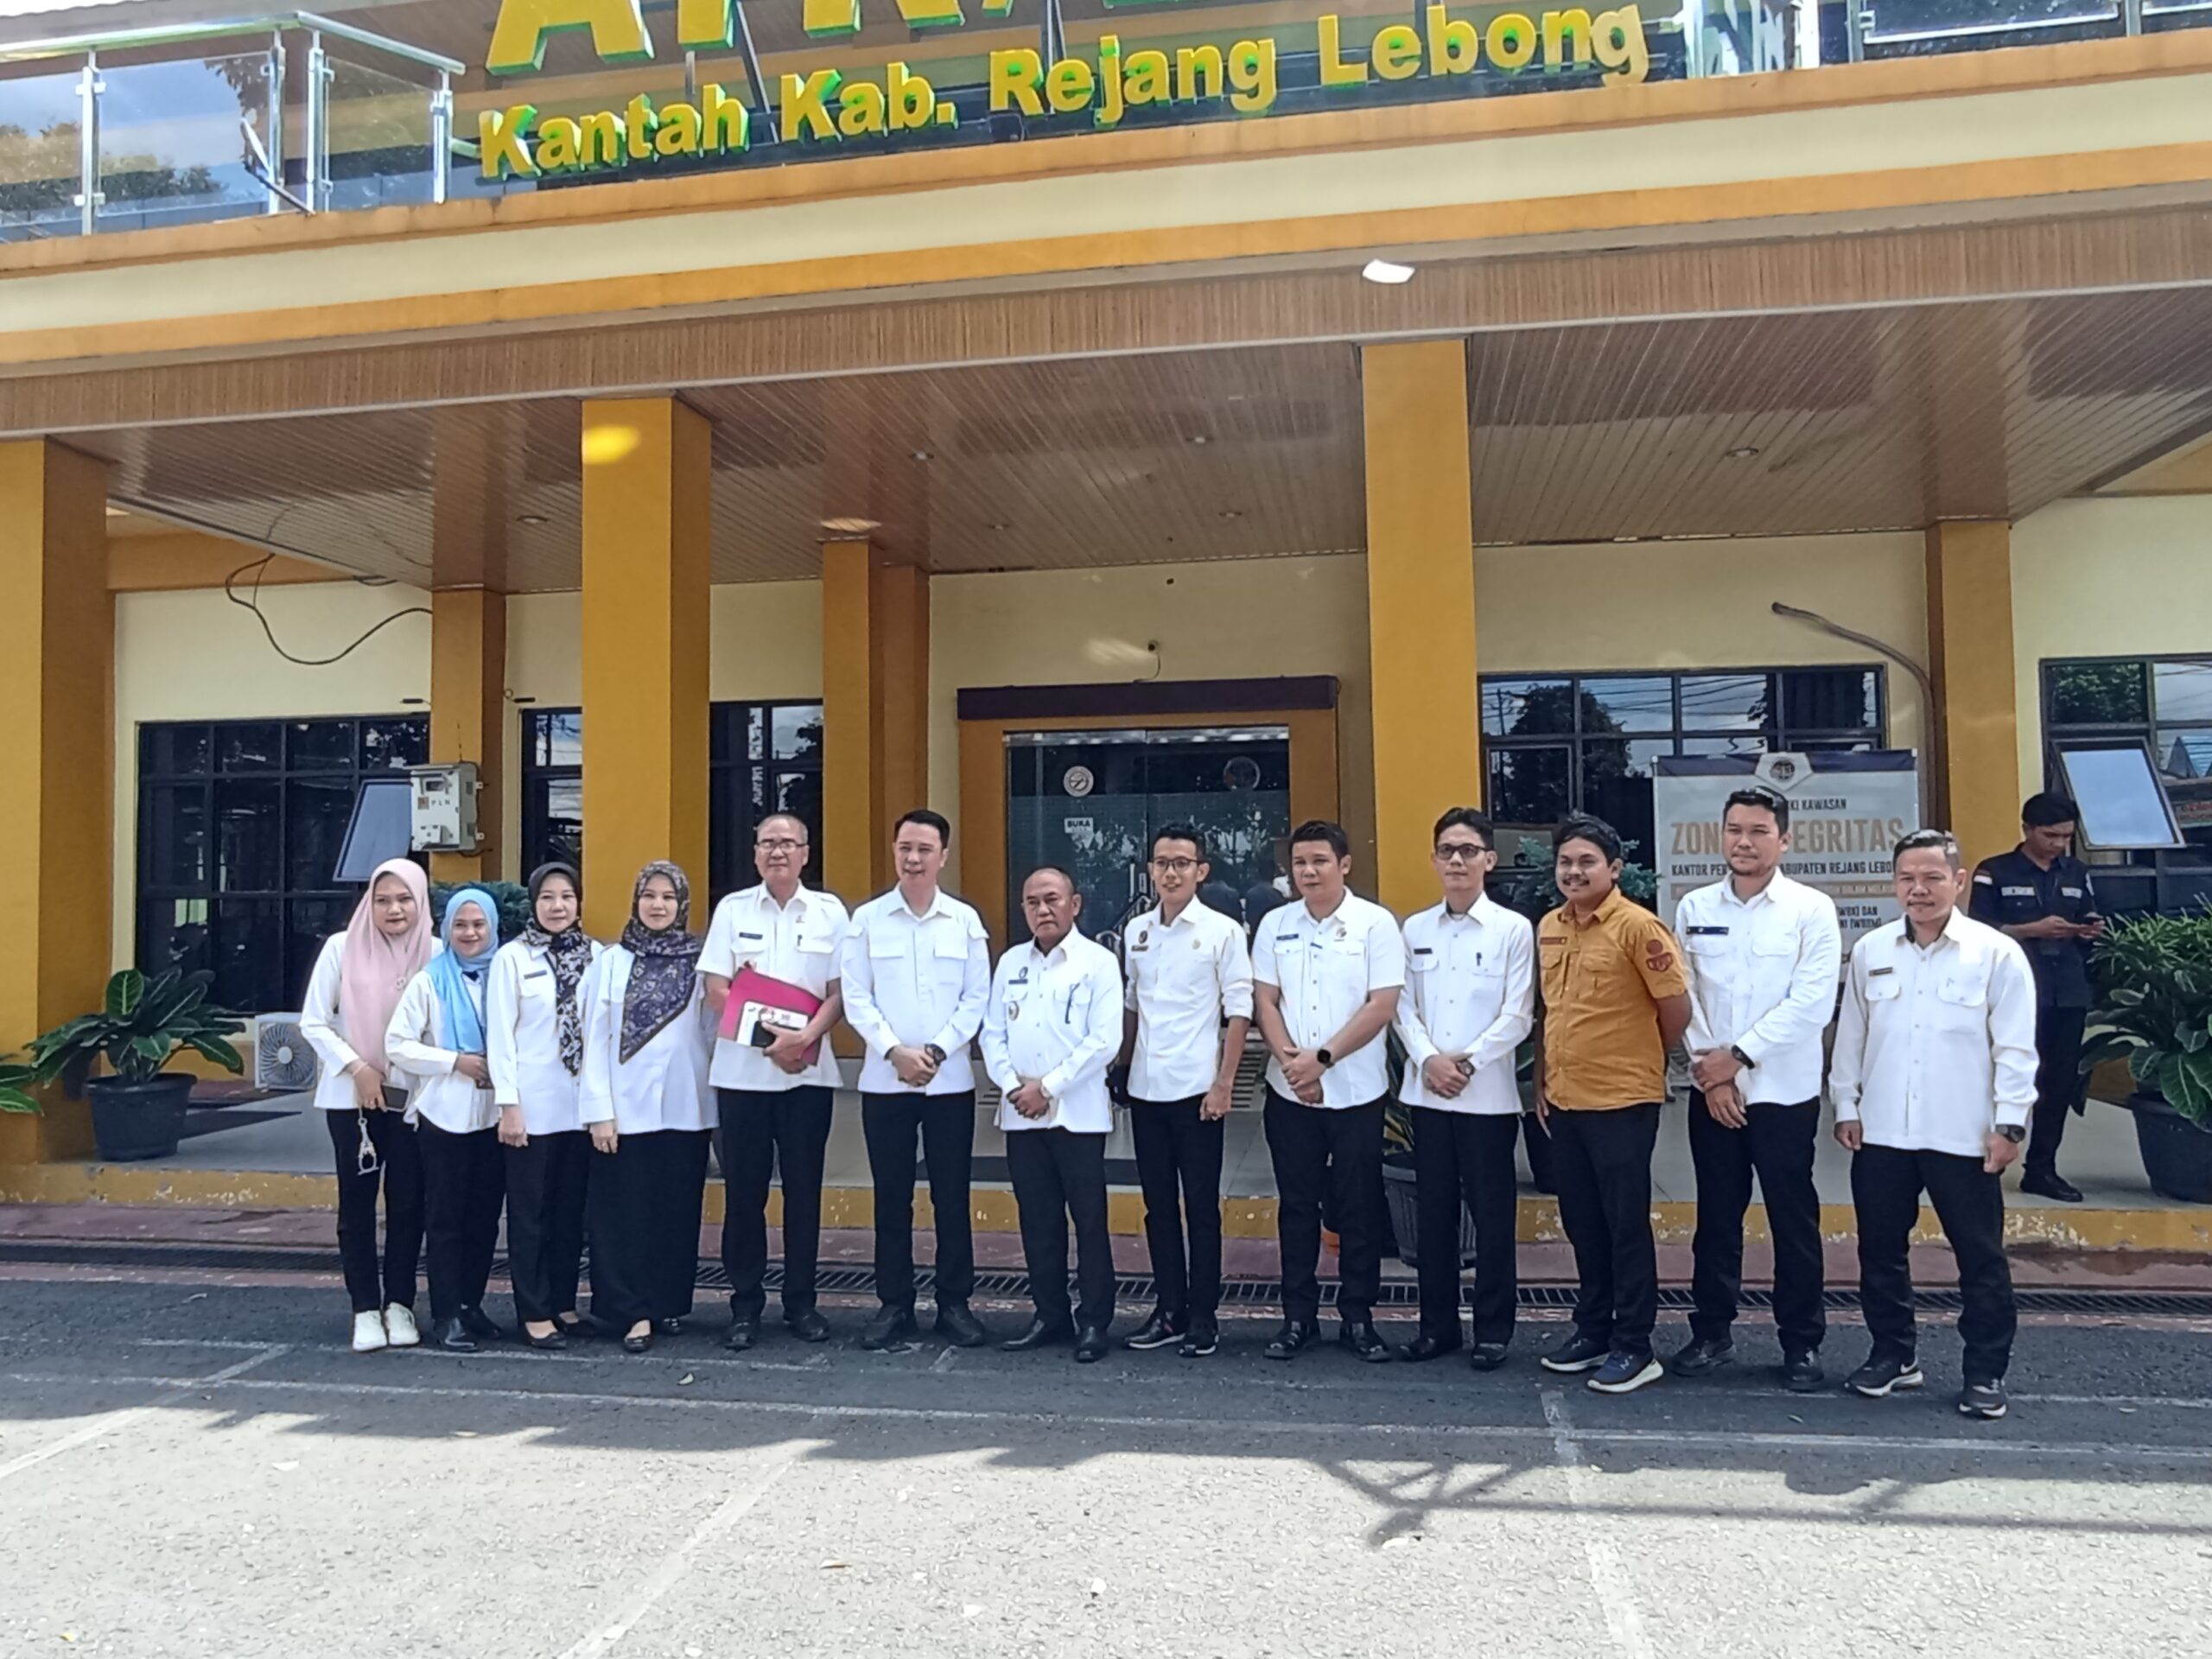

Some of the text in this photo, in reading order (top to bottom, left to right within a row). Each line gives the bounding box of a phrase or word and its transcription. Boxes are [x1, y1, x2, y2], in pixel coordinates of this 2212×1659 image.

[480, 85, 749, 178] Kantah
[780, 62, 957, 142] Kab.
[989, 36, 1277, 127] Rejang
[1318, 4, 1649, 86] Lebong
[1802, 798, 1847, 810] KAWASAN
[1671, 817, 1904, 855] ZON EGRITAS
[1672, 865, 1707, 876] KANTOR
[1780, 862, 1826, 874] ABUPATEN
[1829, 861, 1866, 874] REJANG
[1869, 861, 1893, 874] LEBO
